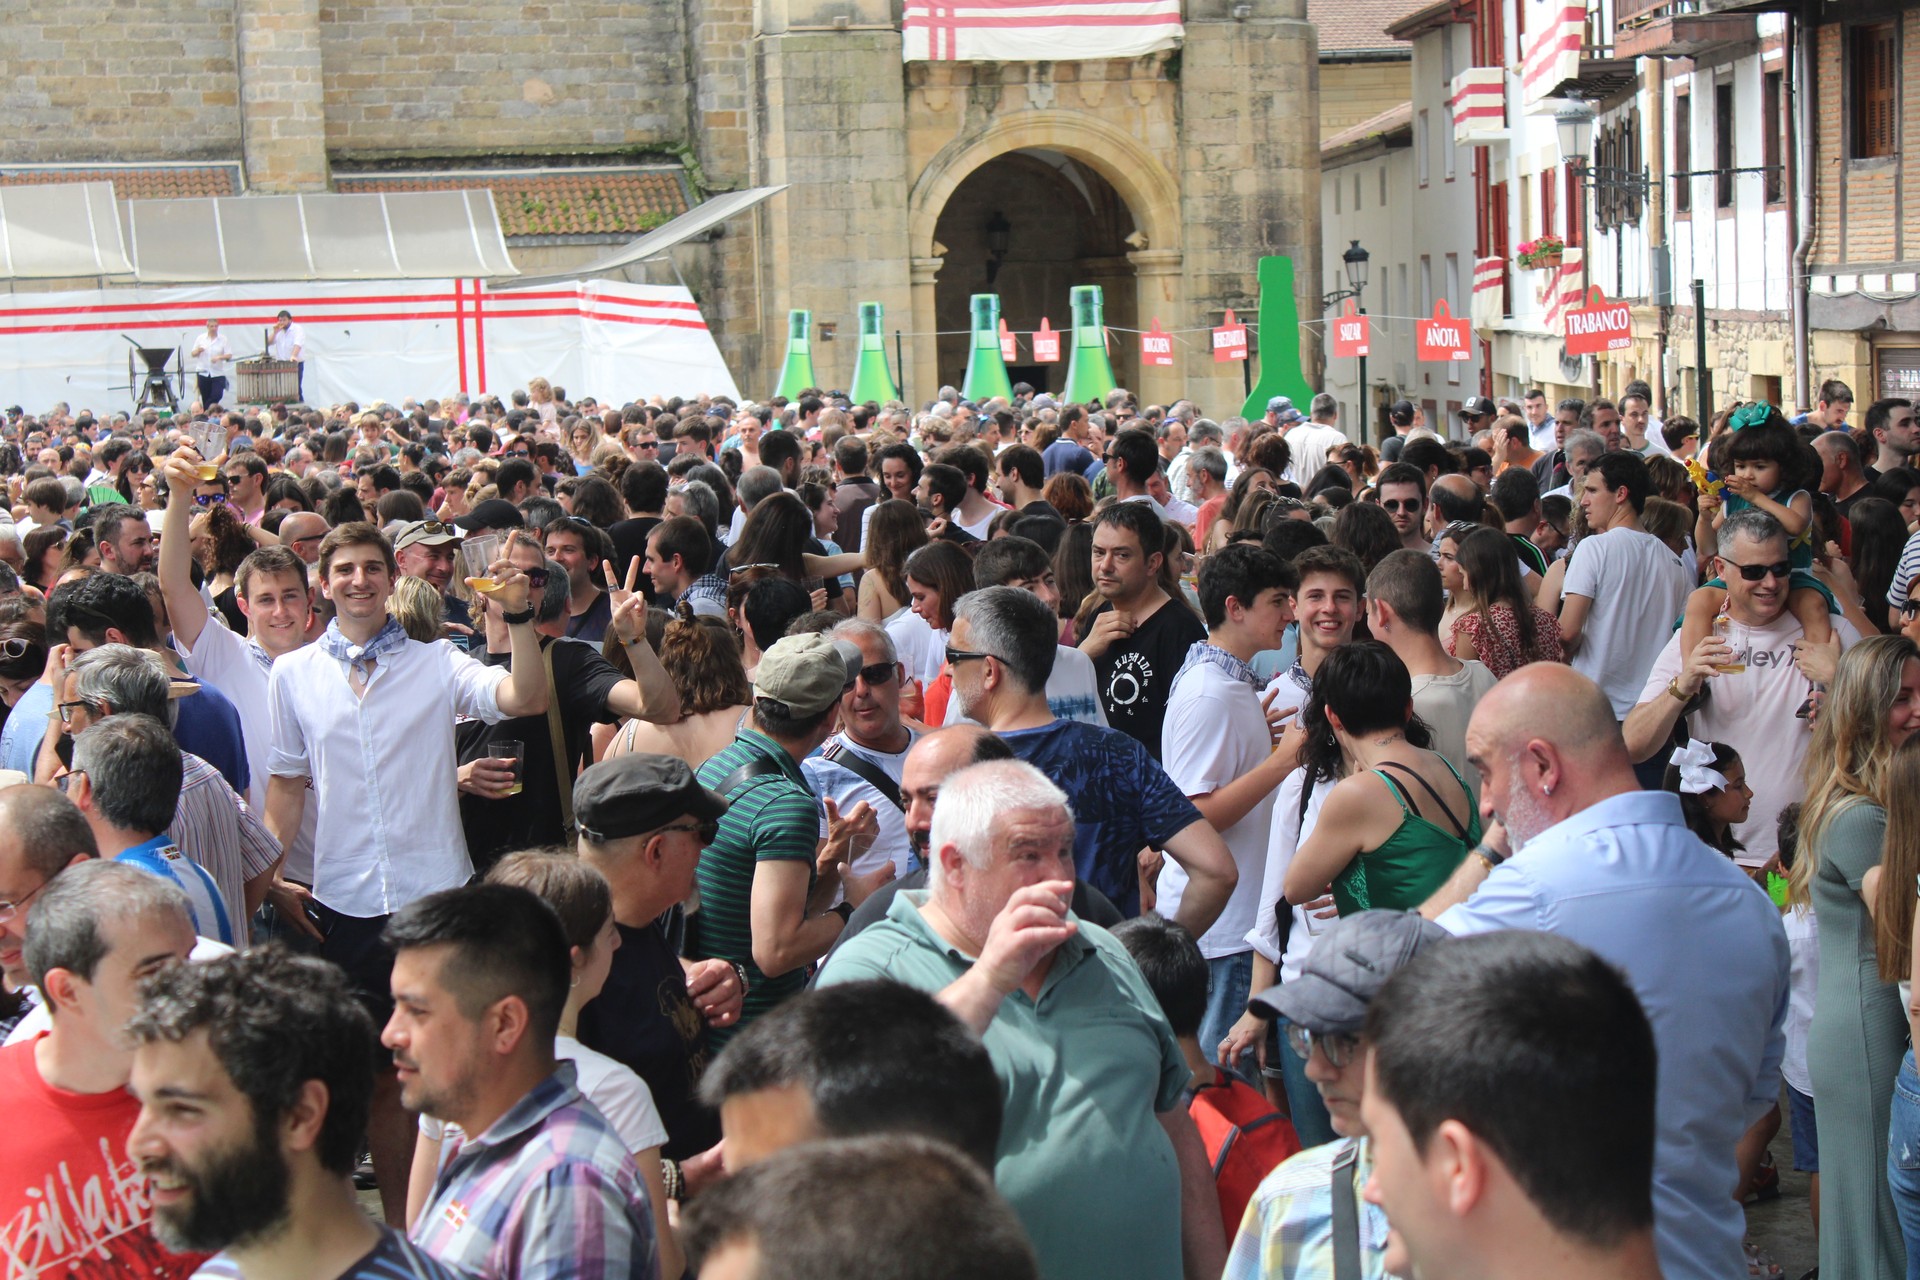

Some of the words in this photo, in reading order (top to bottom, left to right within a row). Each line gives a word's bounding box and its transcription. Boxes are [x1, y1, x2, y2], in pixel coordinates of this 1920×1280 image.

[1425, 322, 1461, 348] AÑOTA
[1566, 308, 1629, 336] TRABANCO
[1740, 644, 1785, 669] ley
